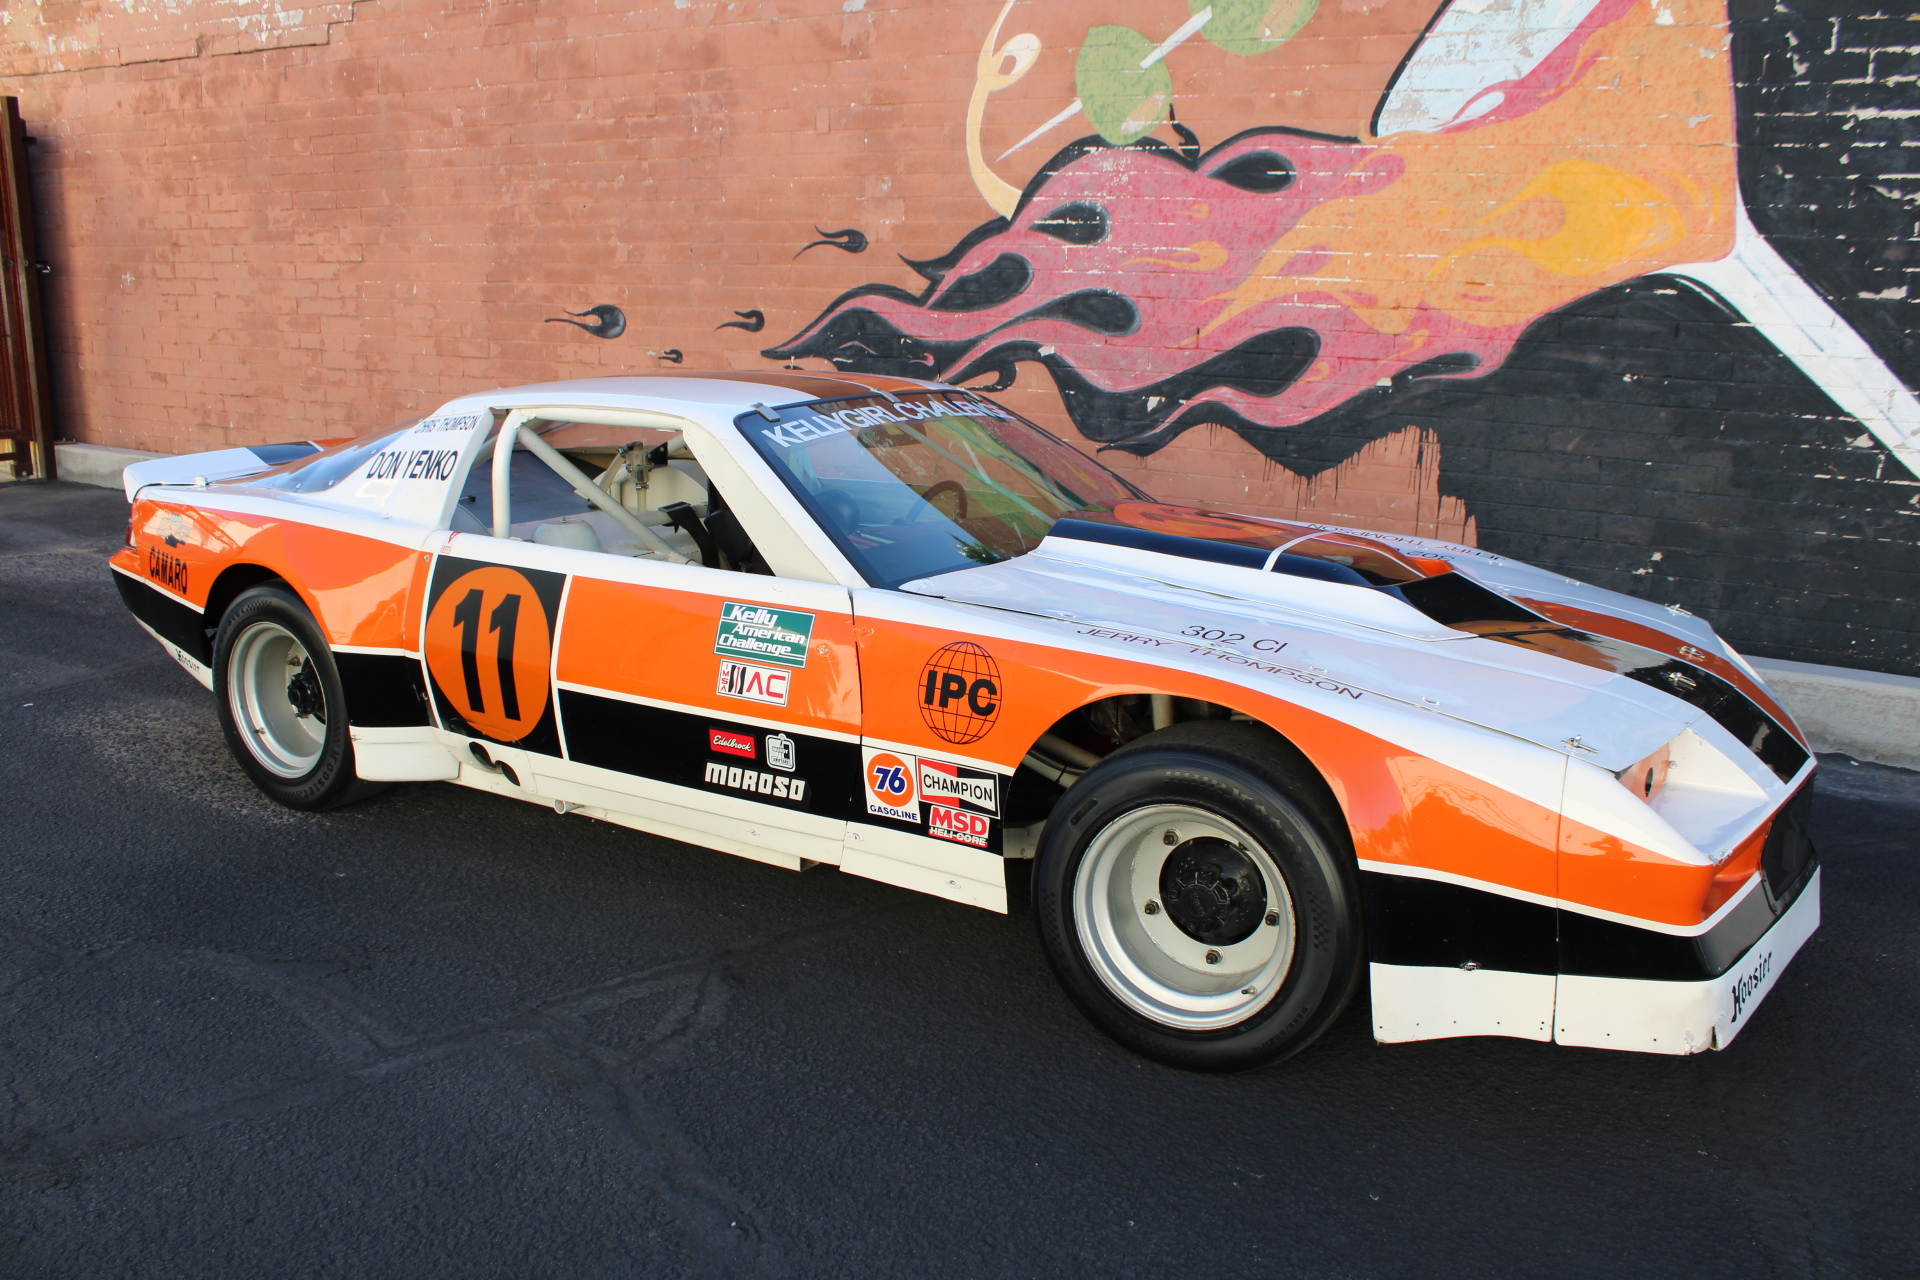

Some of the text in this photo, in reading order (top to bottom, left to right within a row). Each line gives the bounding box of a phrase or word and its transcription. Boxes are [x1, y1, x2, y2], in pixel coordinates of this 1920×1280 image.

[437, 415, 481, 432] THOMPSON
[366, 450, 458, 481] DON YENKO
[1308, 523, 1424, 546] THOMPSON
[149, 545, 188, 595] CAMARO
[729, 605, 778, 629] Kelly
[718, 634, 791, 656] Challenge
[731, 623, 806, 645] American
[1180, 625, 1288, 653] 302 CI
[453, 588, 522, 722] 11
[1077, 629, 1363, 700] JERRY THOMPSON
[924, 669, 998, 716] IPC
[713, 735, 752, 752] Edelbrock
[705, 762, 806, 802] MOROSO
[873, 765, 907, 795] 76
[923, 773, 993, 802] CHAMPION
[870, 804, 918, 821] GASOLINE
[931, 806, 987, 836] MSD
[929, 827, 988, 847] HELI-CORE
[1730, 951, 1772, 1023] Hoosier
